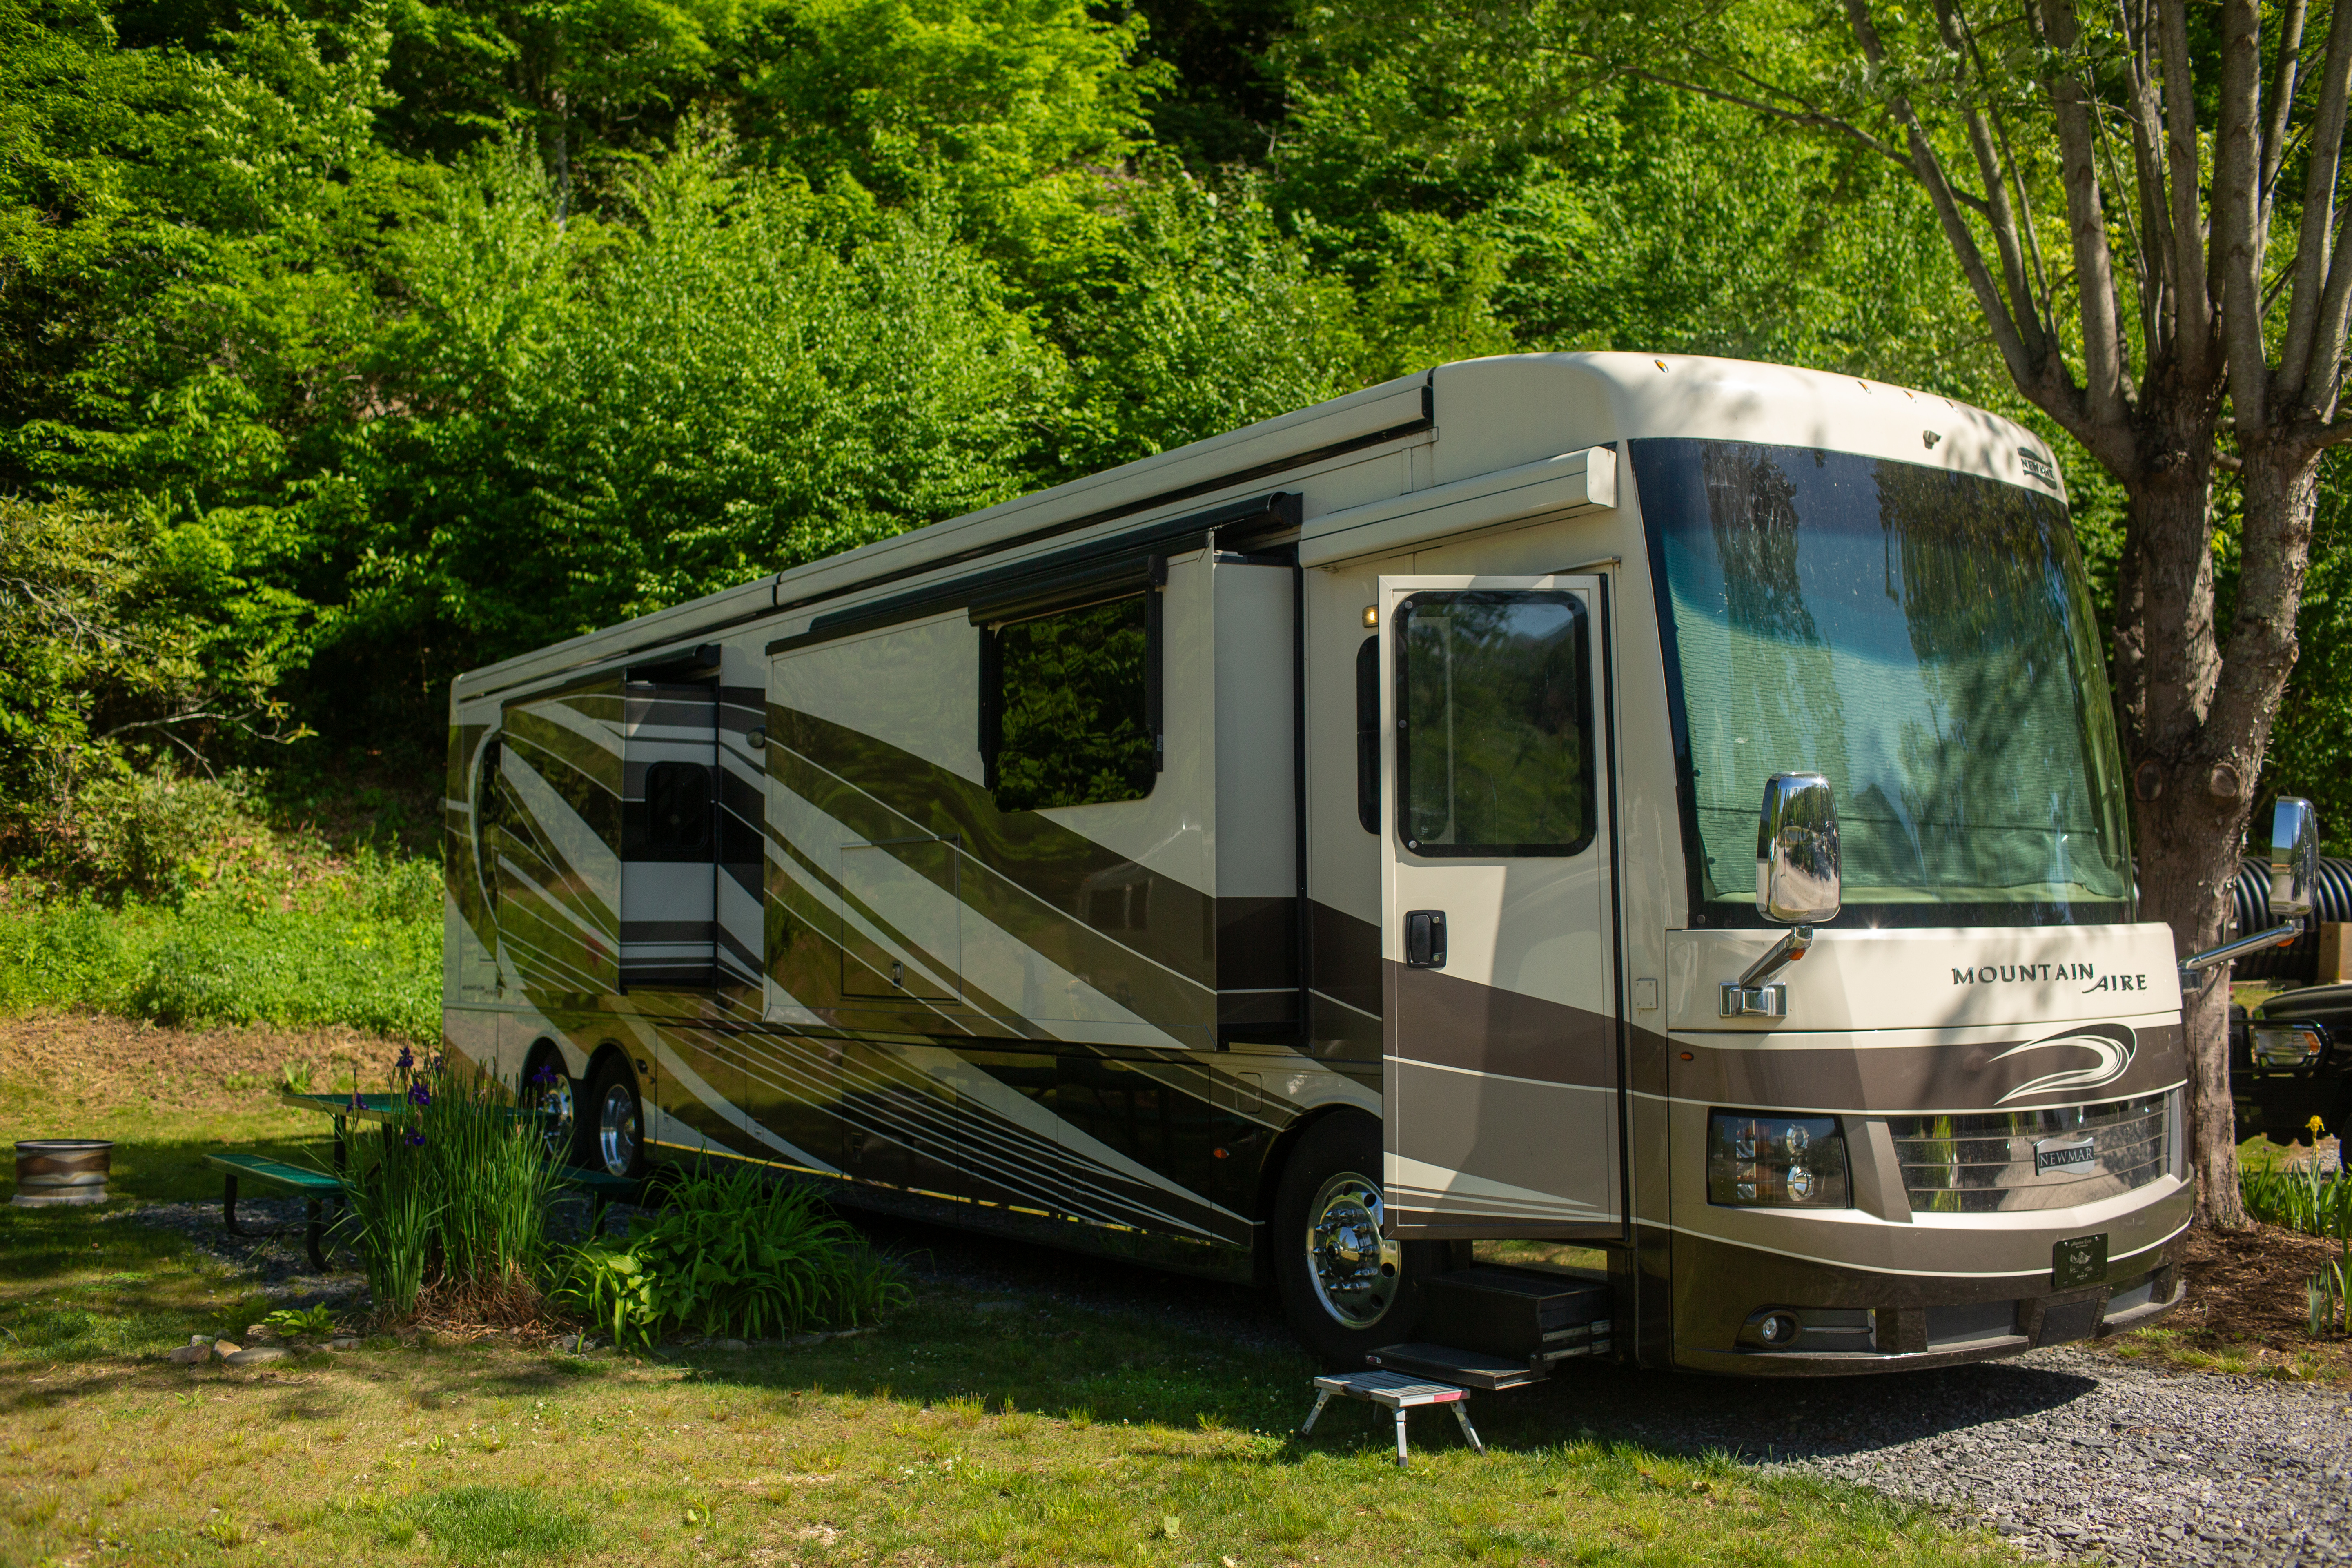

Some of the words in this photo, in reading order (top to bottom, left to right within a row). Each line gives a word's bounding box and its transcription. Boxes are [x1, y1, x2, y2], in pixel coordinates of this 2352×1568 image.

[2021, 458, 2054, 479] NEWMAR
[1951, 963, 2094, 985] MOUNTAIN
[2082, 974, 2147, 994] AIRE
[2040, 1147, 2094, 1167] NEWMAR
